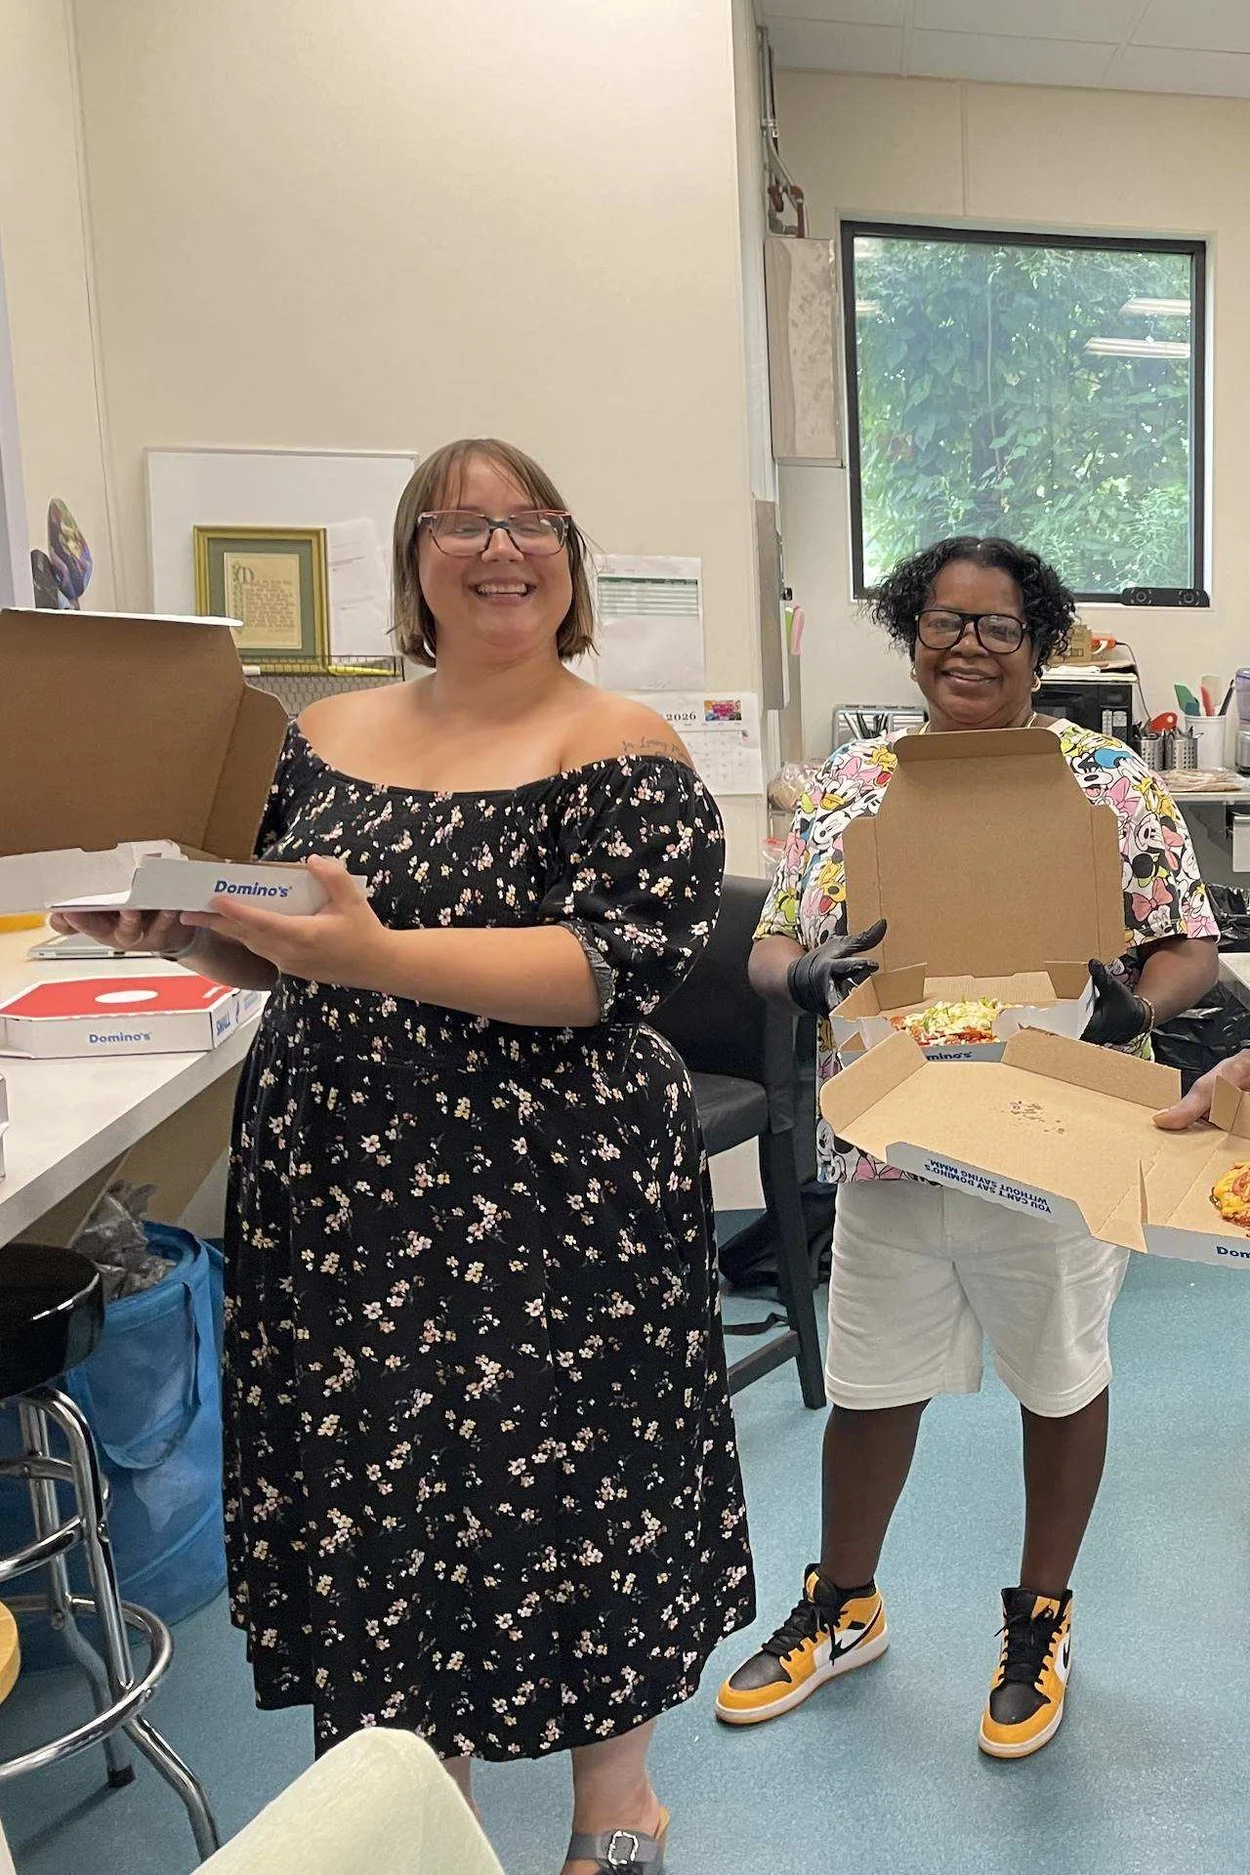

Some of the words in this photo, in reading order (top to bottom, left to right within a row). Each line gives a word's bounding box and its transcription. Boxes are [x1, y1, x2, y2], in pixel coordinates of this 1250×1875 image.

[665, 712, 697, 721] 2026
[214, 879, 291, 898] Domino's
[88, 1031, 151, 1044] Domino's
[926, 1051, 972, 1061] mino's
[924, 1163, 975, 1187] DOMINO'S
[960, 1170, 998, 1188] SAYING
[976, 1182, 996, 1194] SAY
[1000, 1183, 1048, 1206] WITHOUT
[998, 1189, 1029, 1206] CAN'T
[1030, 1201, 1052, 1214] YOU
